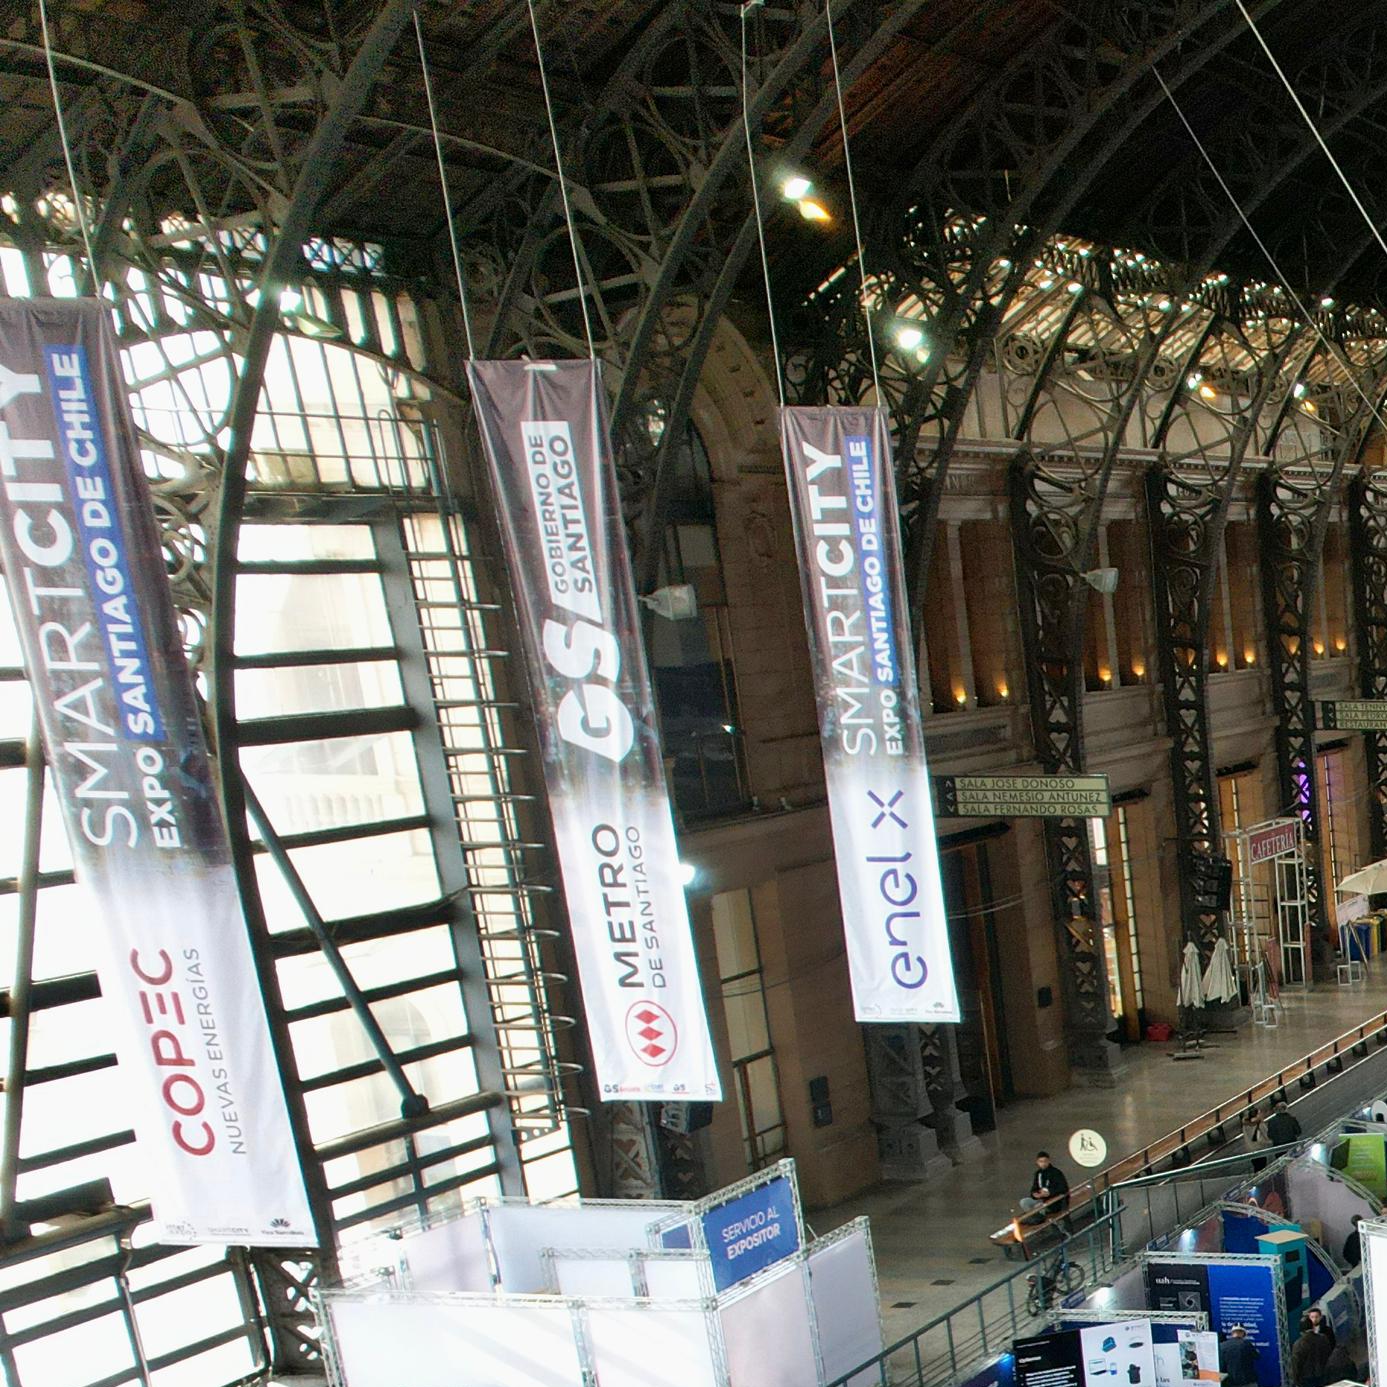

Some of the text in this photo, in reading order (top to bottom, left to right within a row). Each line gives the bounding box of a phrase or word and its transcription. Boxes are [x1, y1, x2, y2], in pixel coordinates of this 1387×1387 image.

[532, 433, 569, 595] GOBIERNO DE
[548, 433, 593, 594] SANTIAGO
[0, 364, 138, 849] SMARTCITY
[52, 352, 181, 849] EXPO SANTIAGO DE CHILE
[801, 440, 877, 757] SMARTCITY
[849, 439, 904, 756] EXPO SANTIAGO DE CHILE
[543, 618, 635, 763] GS
[959, 778, 989, 790] SALA
[1021, 778, 1075, 790] DONOSO
[961, 791, 1102, 802] SALA NEMESIO ANTUNEZ
[962, 803, 1099, 815] SALA FERNANDO ROSAS
[590, 822, 645, 989] METRO
[625, 825, 667, 989] DE SANTIAGO
[865, 851, 929, 990] enel
[129, 947, 215, 1157] COPEC
[183, 947, 247, 1156] NUEVAS ENERGÍAS
[721, 1205, 781, 1243] SERVICIO AL
[726, 1222, 782, 1261] EXPOSITOR
